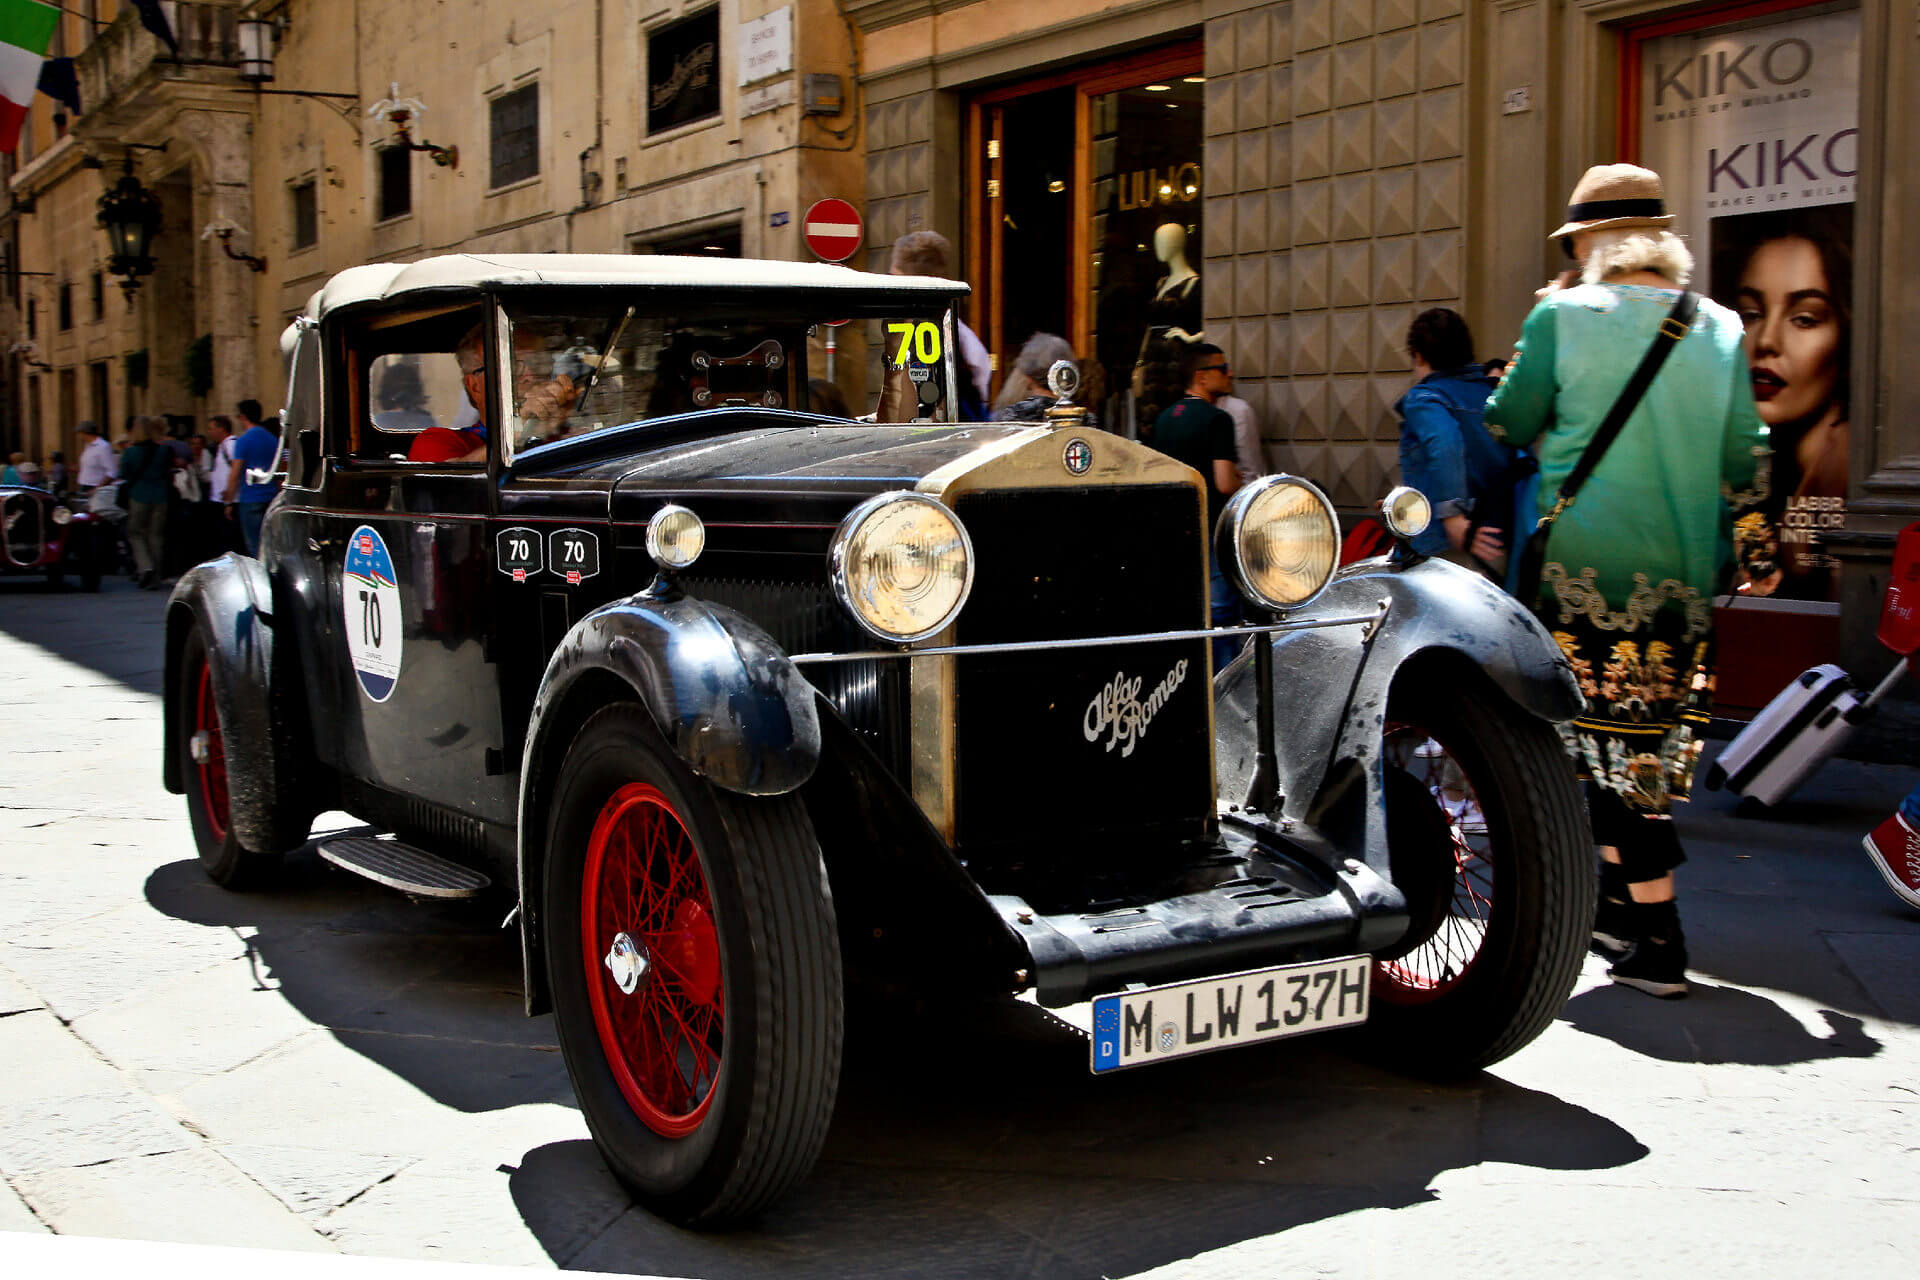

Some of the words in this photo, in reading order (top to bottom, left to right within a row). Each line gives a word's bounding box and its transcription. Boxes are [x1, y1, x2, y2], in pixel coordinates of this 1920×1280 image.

[1654, 38, 1814, 107] KIKO
[888, 322, 941, 365] 70
[1784, 512, 1846, 529] COLOR
[509, 539, 529, 561] 70
[564, 541, 585, 563] 70
[359, 590, 382, 649] 70
[1117, 658, 1188, 758] Romeo
[1124, 1000, 1153, 1057] M
[1186, 984, 1243, 1045] LW
[1255, 965, 1366, 1032] 137H
[1101, 1041, 1113, 1057] D
